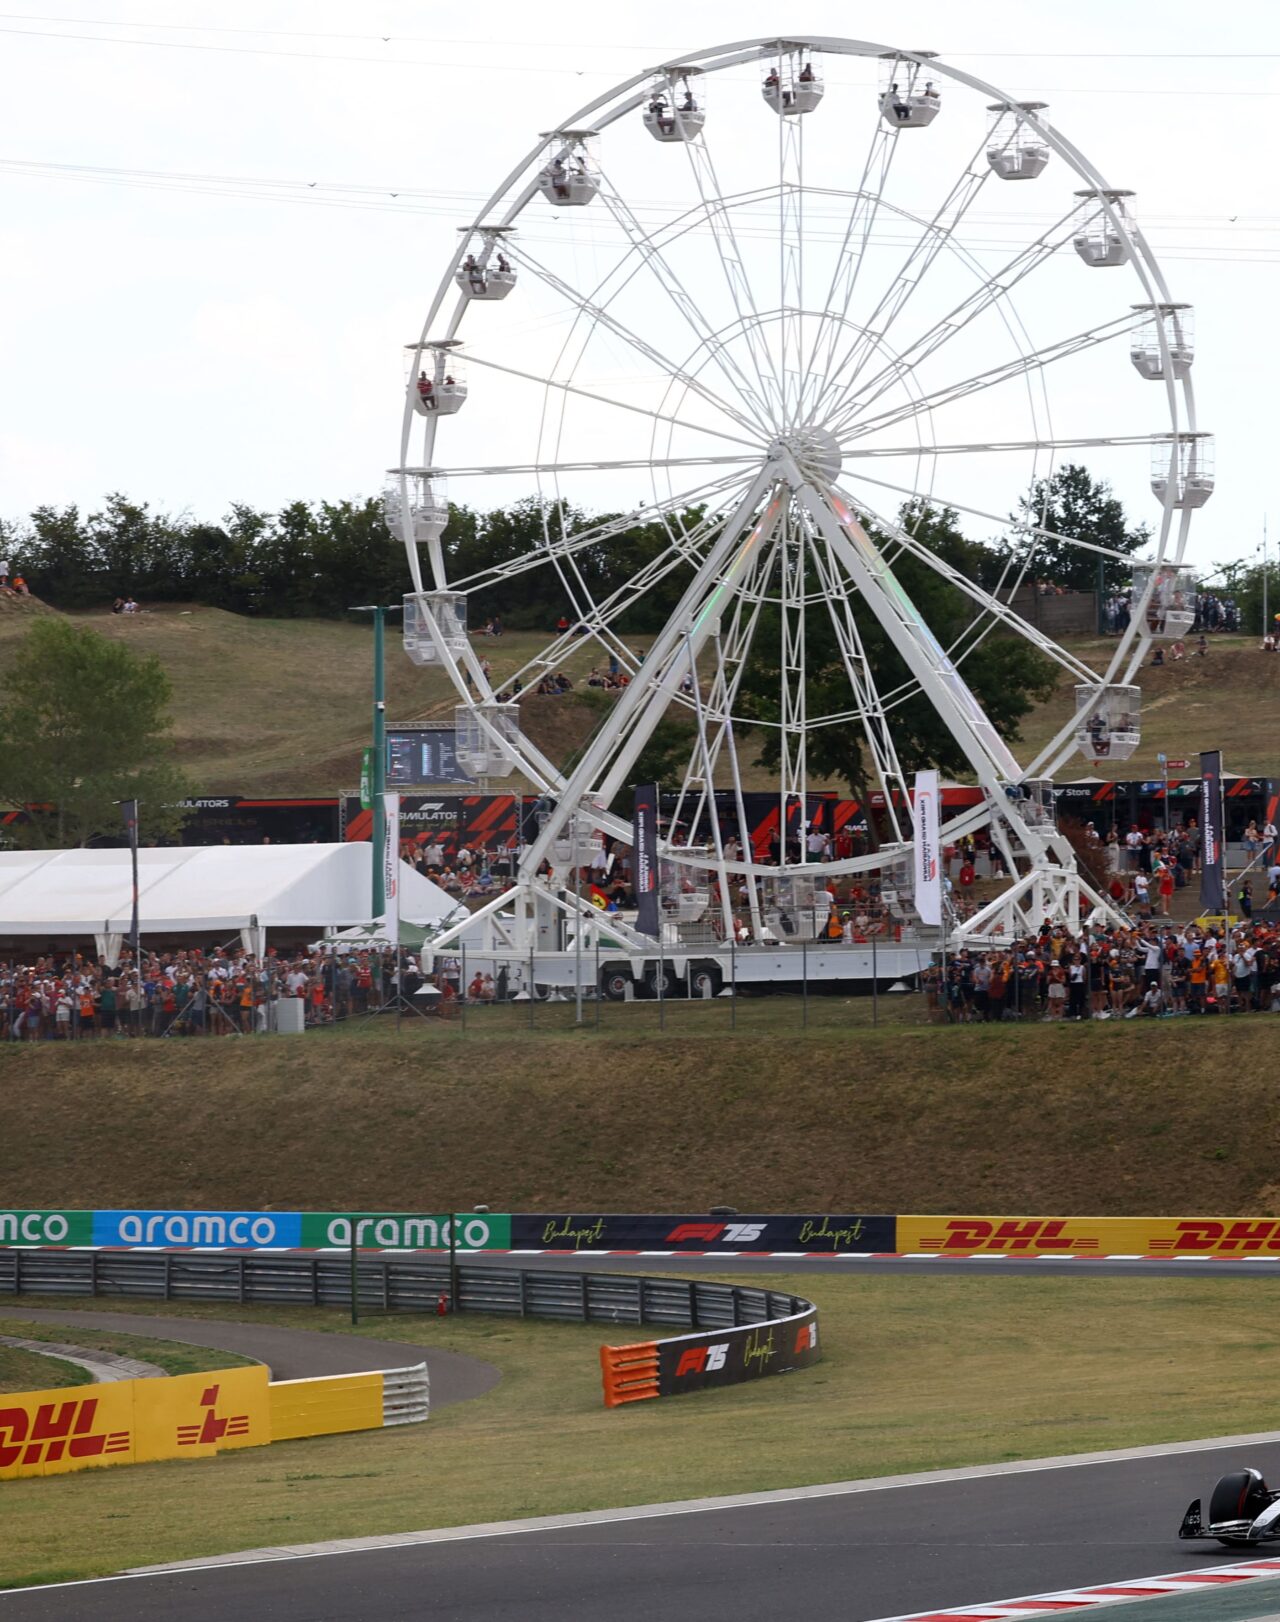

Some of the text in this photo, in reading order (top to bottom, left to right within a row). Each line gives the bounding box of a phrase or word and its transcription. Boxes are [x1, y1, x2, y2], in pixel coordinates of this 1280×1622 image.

[119, 1215, 276, 1244] aramco
[327, 1218, 490, 1247] aramco
[543, 1216, 607, 1250] Budapest
[799, 1216, 867, 1250] Budapest
[943, 1221, 1074, 1249] DHL
